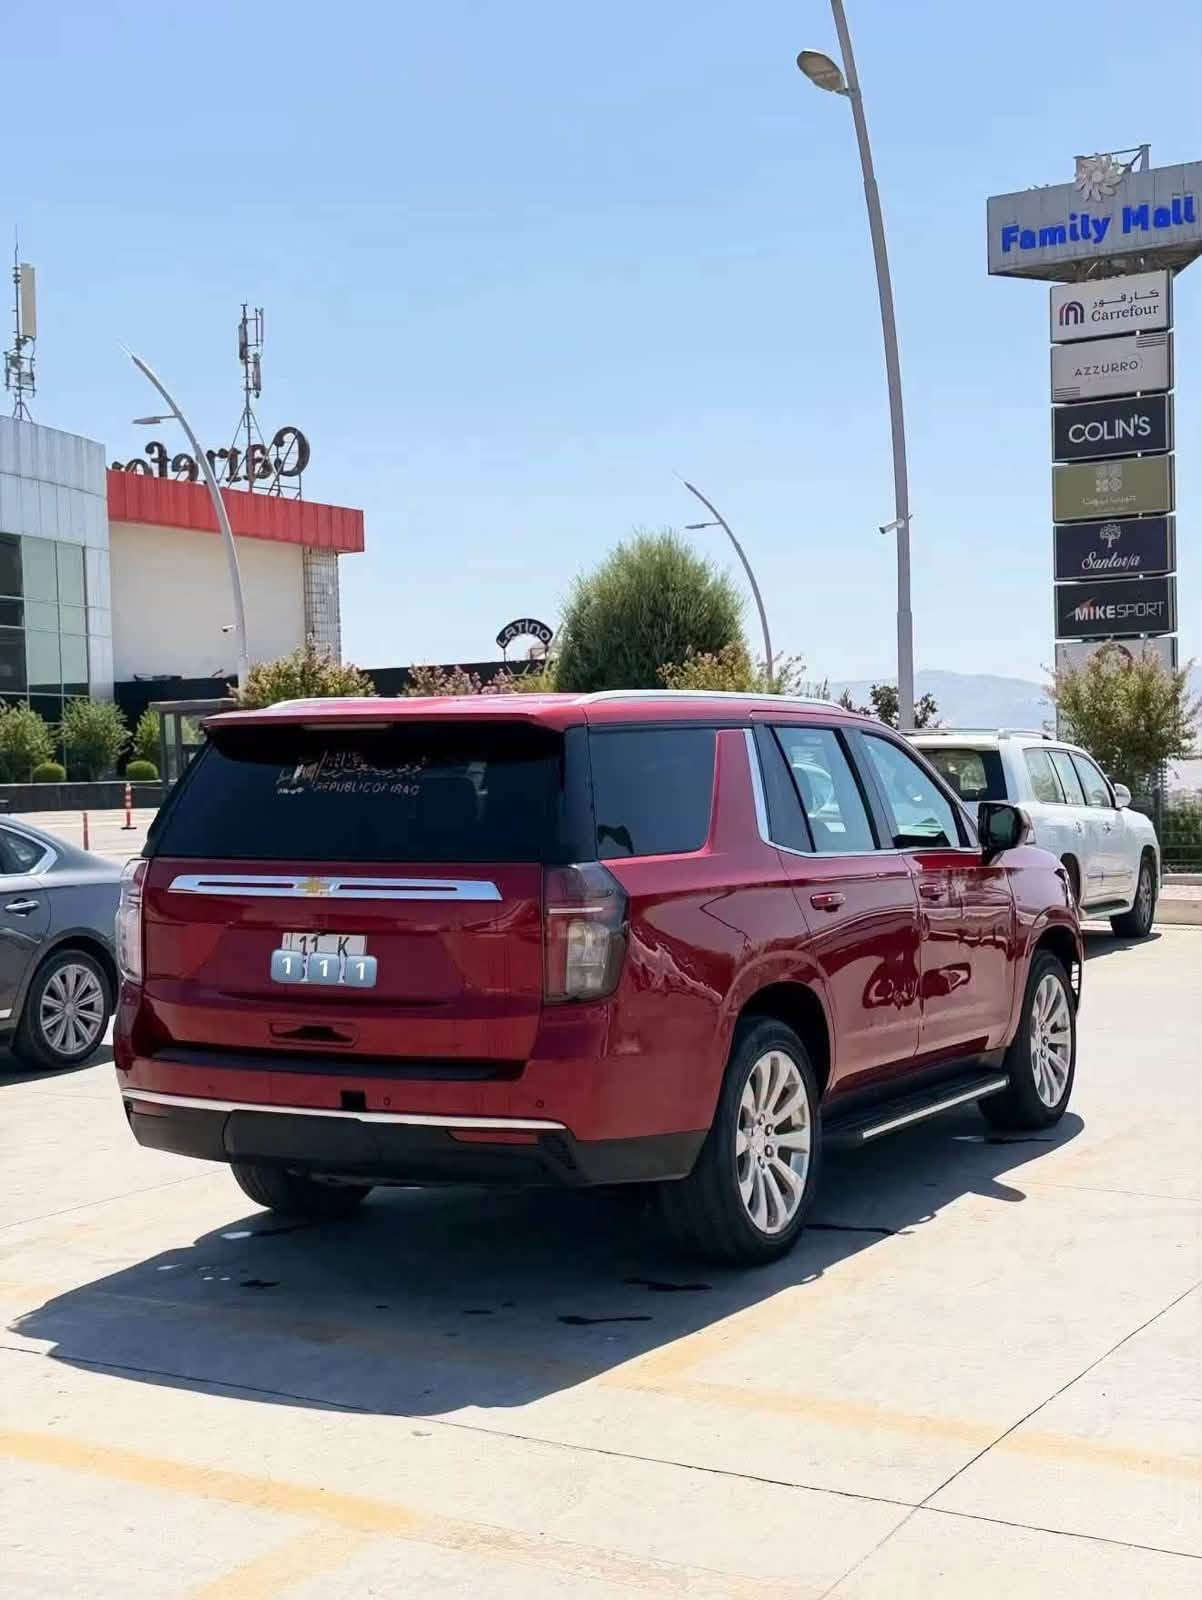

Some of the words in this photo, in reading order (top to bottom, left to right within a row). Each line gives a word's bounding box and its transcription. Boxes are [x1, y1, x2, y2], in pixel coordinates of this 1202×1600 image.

[1001, 213, 1111, 252] Family
[1122, 196, 1195, 234] Mall
[1091, 304, 1159, 322] Carrefour
[1074, 360, 1139, 377] AZZURRO
[1068, 414, 1151, 443] COLIN'S
[337, 936, 350, 958] K
